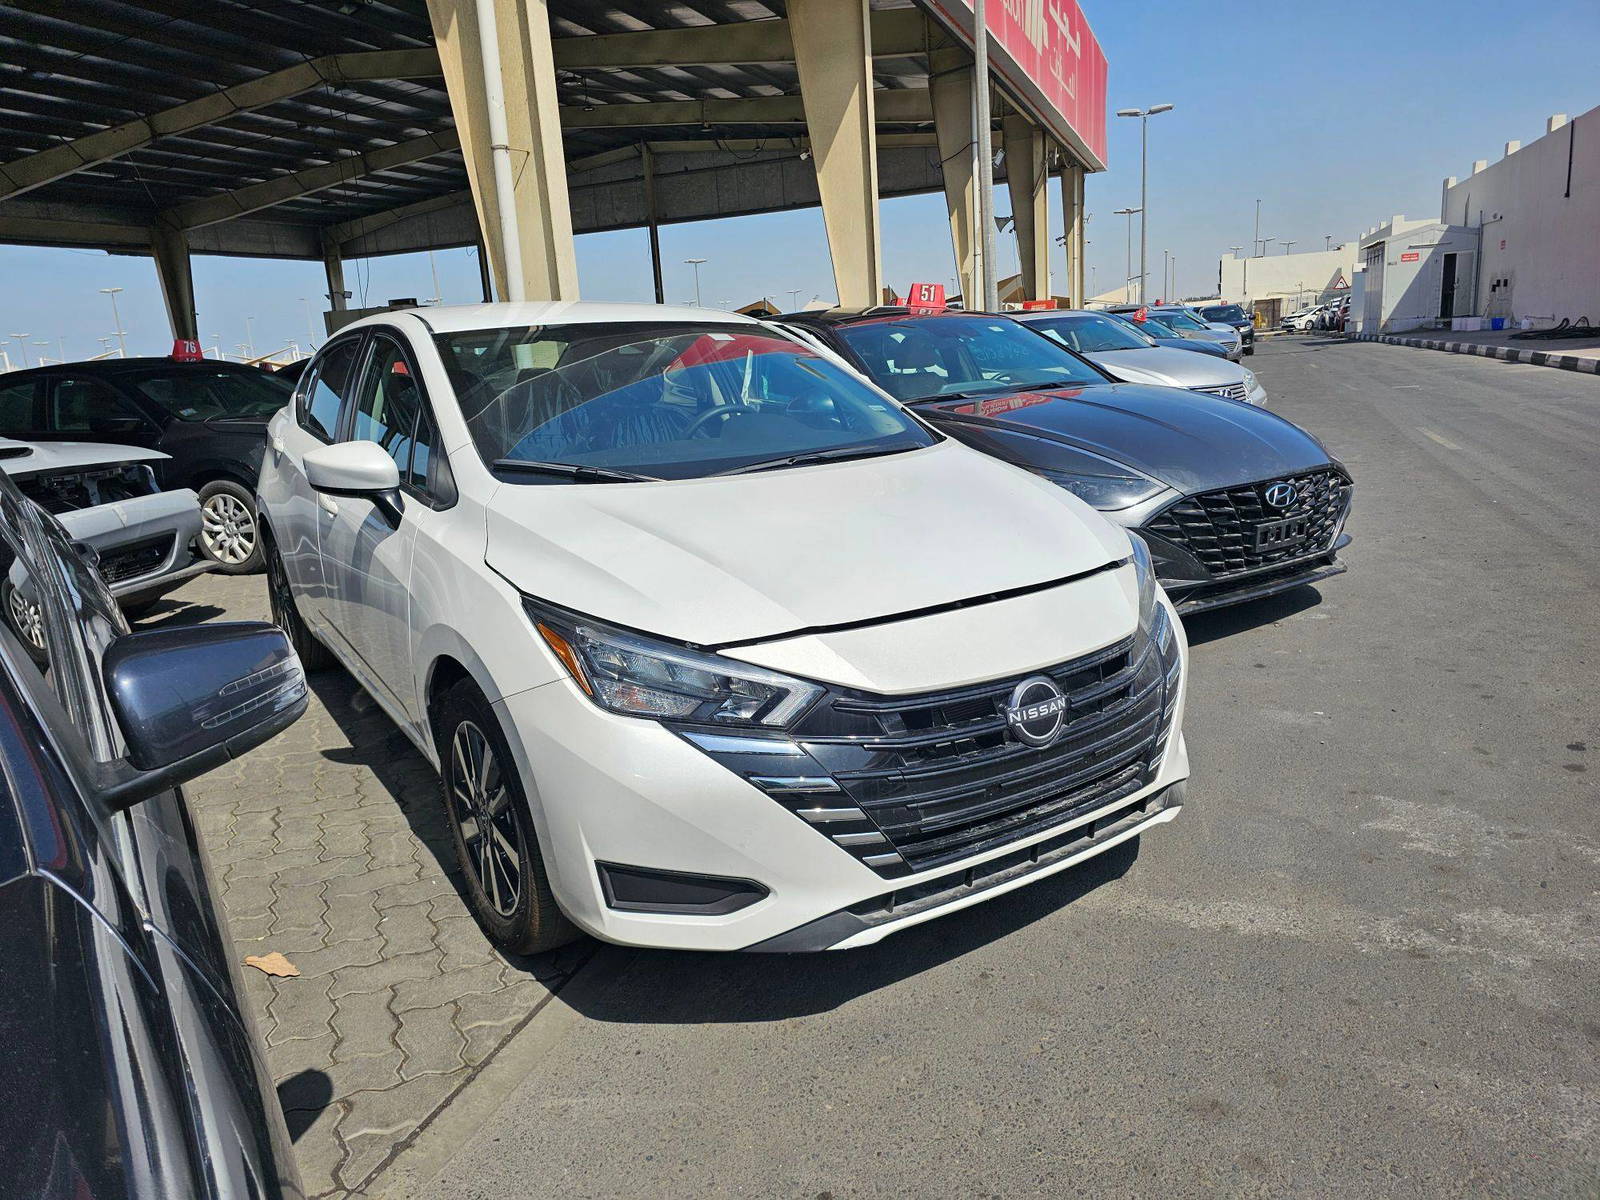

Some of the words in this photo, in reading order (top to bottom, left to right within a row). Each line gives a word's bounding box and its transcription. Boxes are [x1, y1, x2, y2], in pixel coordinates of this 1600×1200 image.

[921, 285, 935, 302] 51
[183, 340, 197, 353] 76
[1008, 697, 1066, 723] NISSAN
